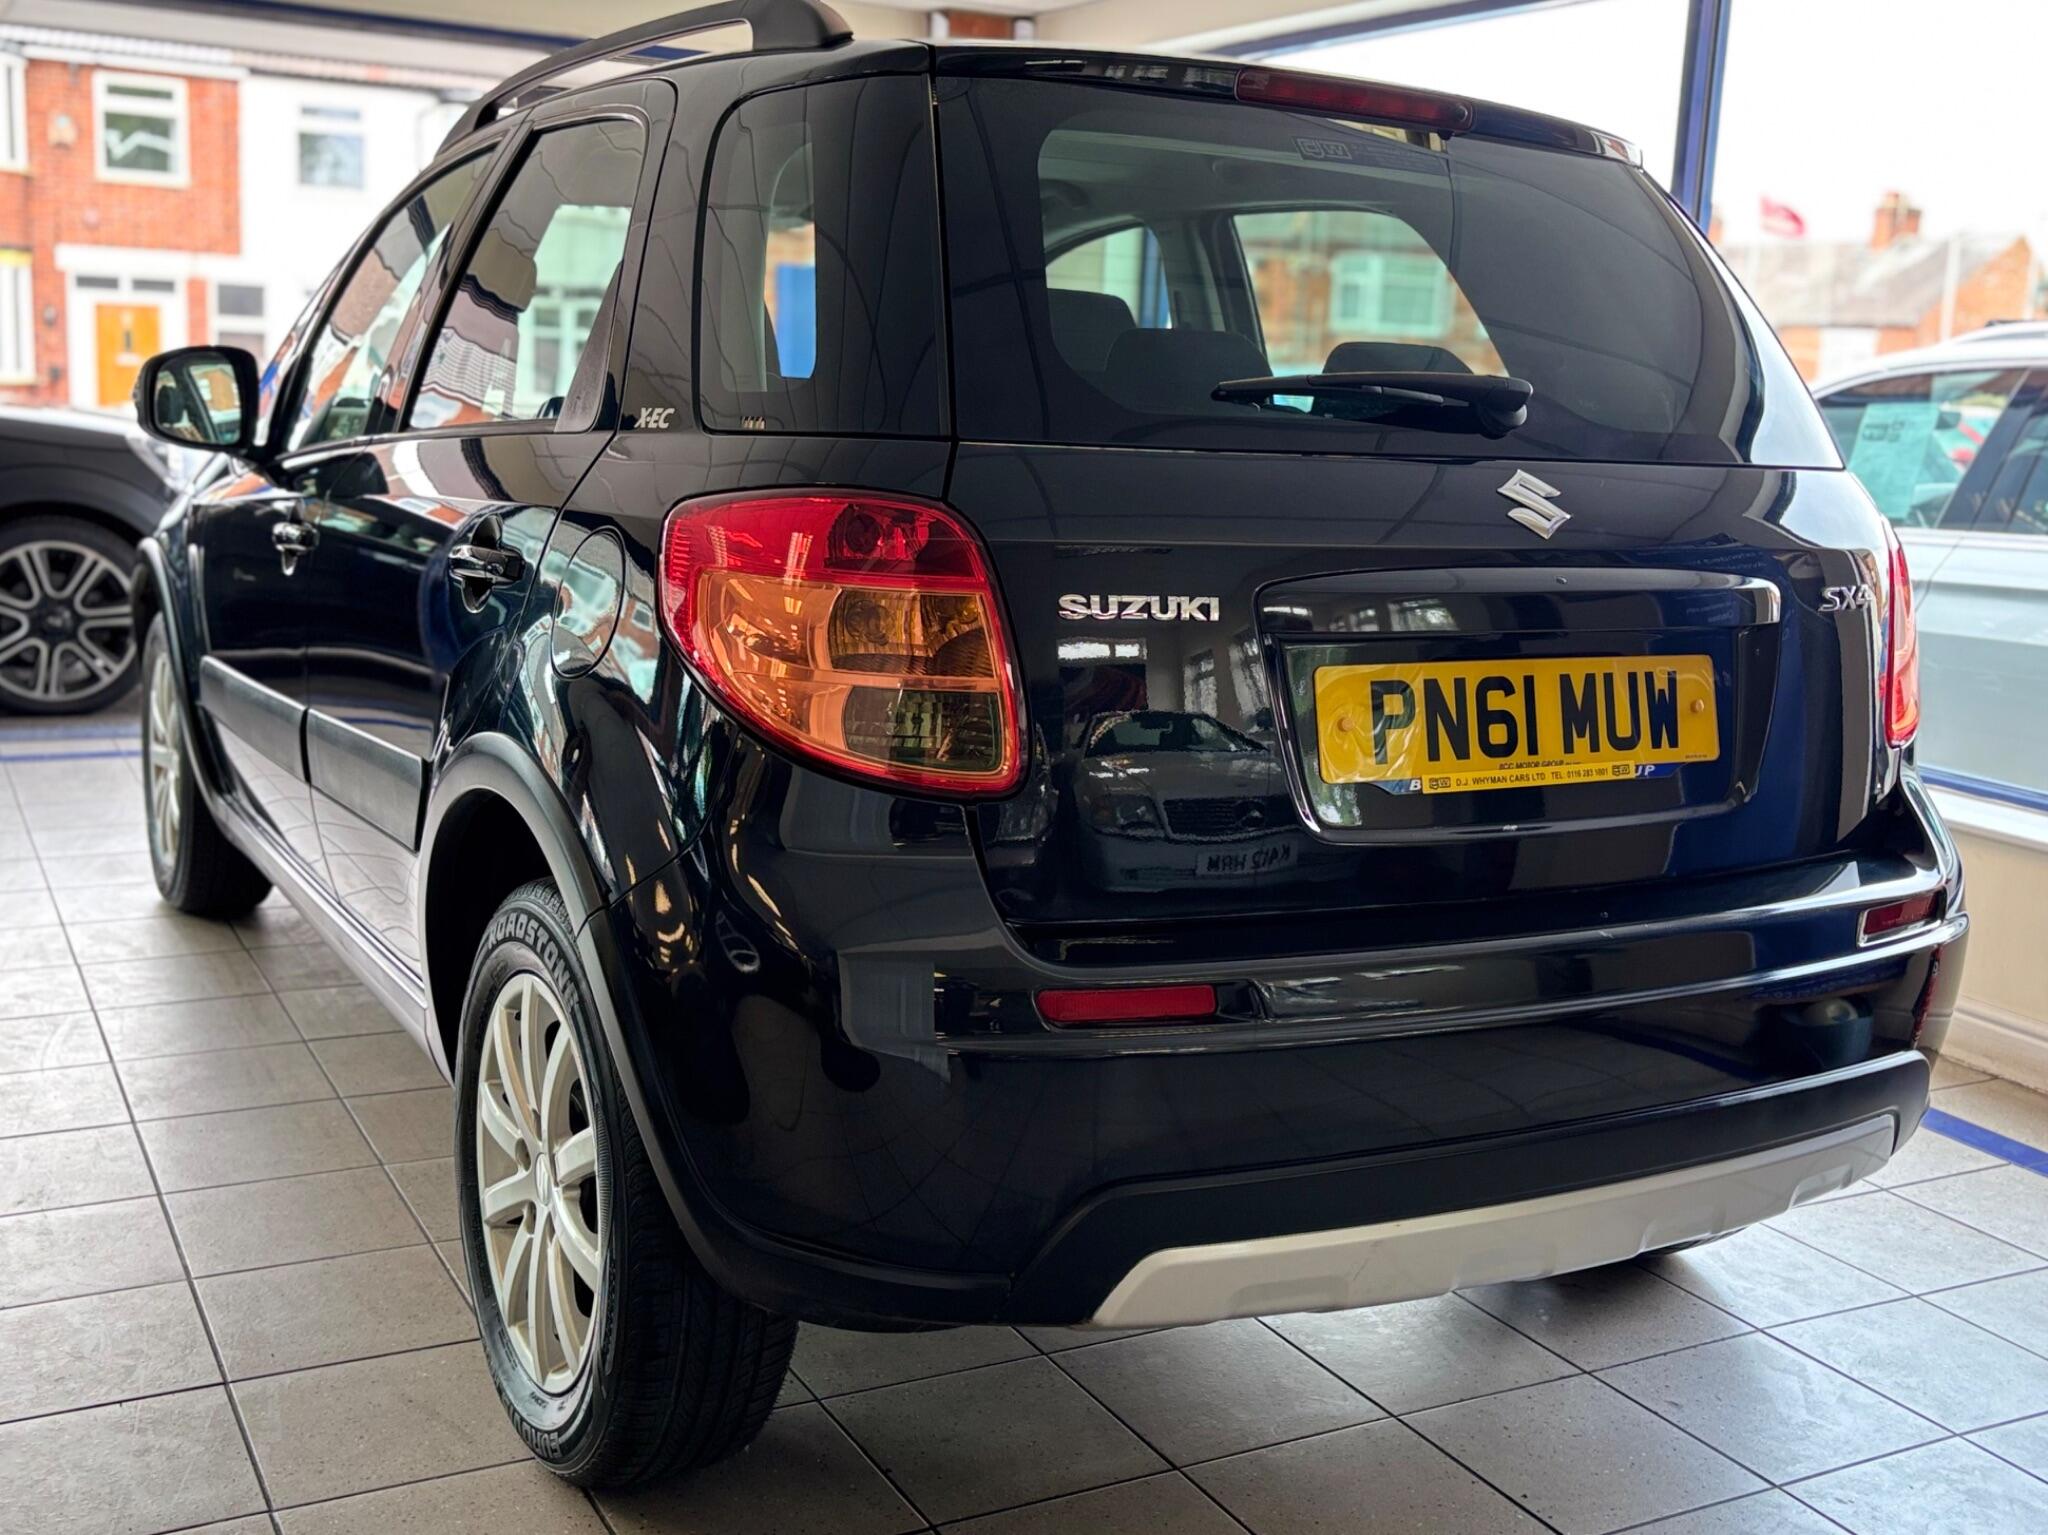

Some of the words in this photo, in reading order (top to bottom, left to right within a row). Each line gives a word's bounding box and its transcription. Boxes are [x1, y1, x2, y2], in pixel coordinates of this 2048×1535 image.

[1058, 593, 1219, 621] SUZUKI
[1817, 583, 1872, 612] SX4
[1370, 674, 1539, 765] PN61
[1559, 670, 1680, 754] MUW
[1471, 774, 1508, 786] WHYMAN
[1509, 772, 1530, 784] CARS
[1531, 770, 1546, 782] LTD
[1515, 760, 1540, 769] MOTOR
[488, 912, 580, 1013] ROADSTONE
